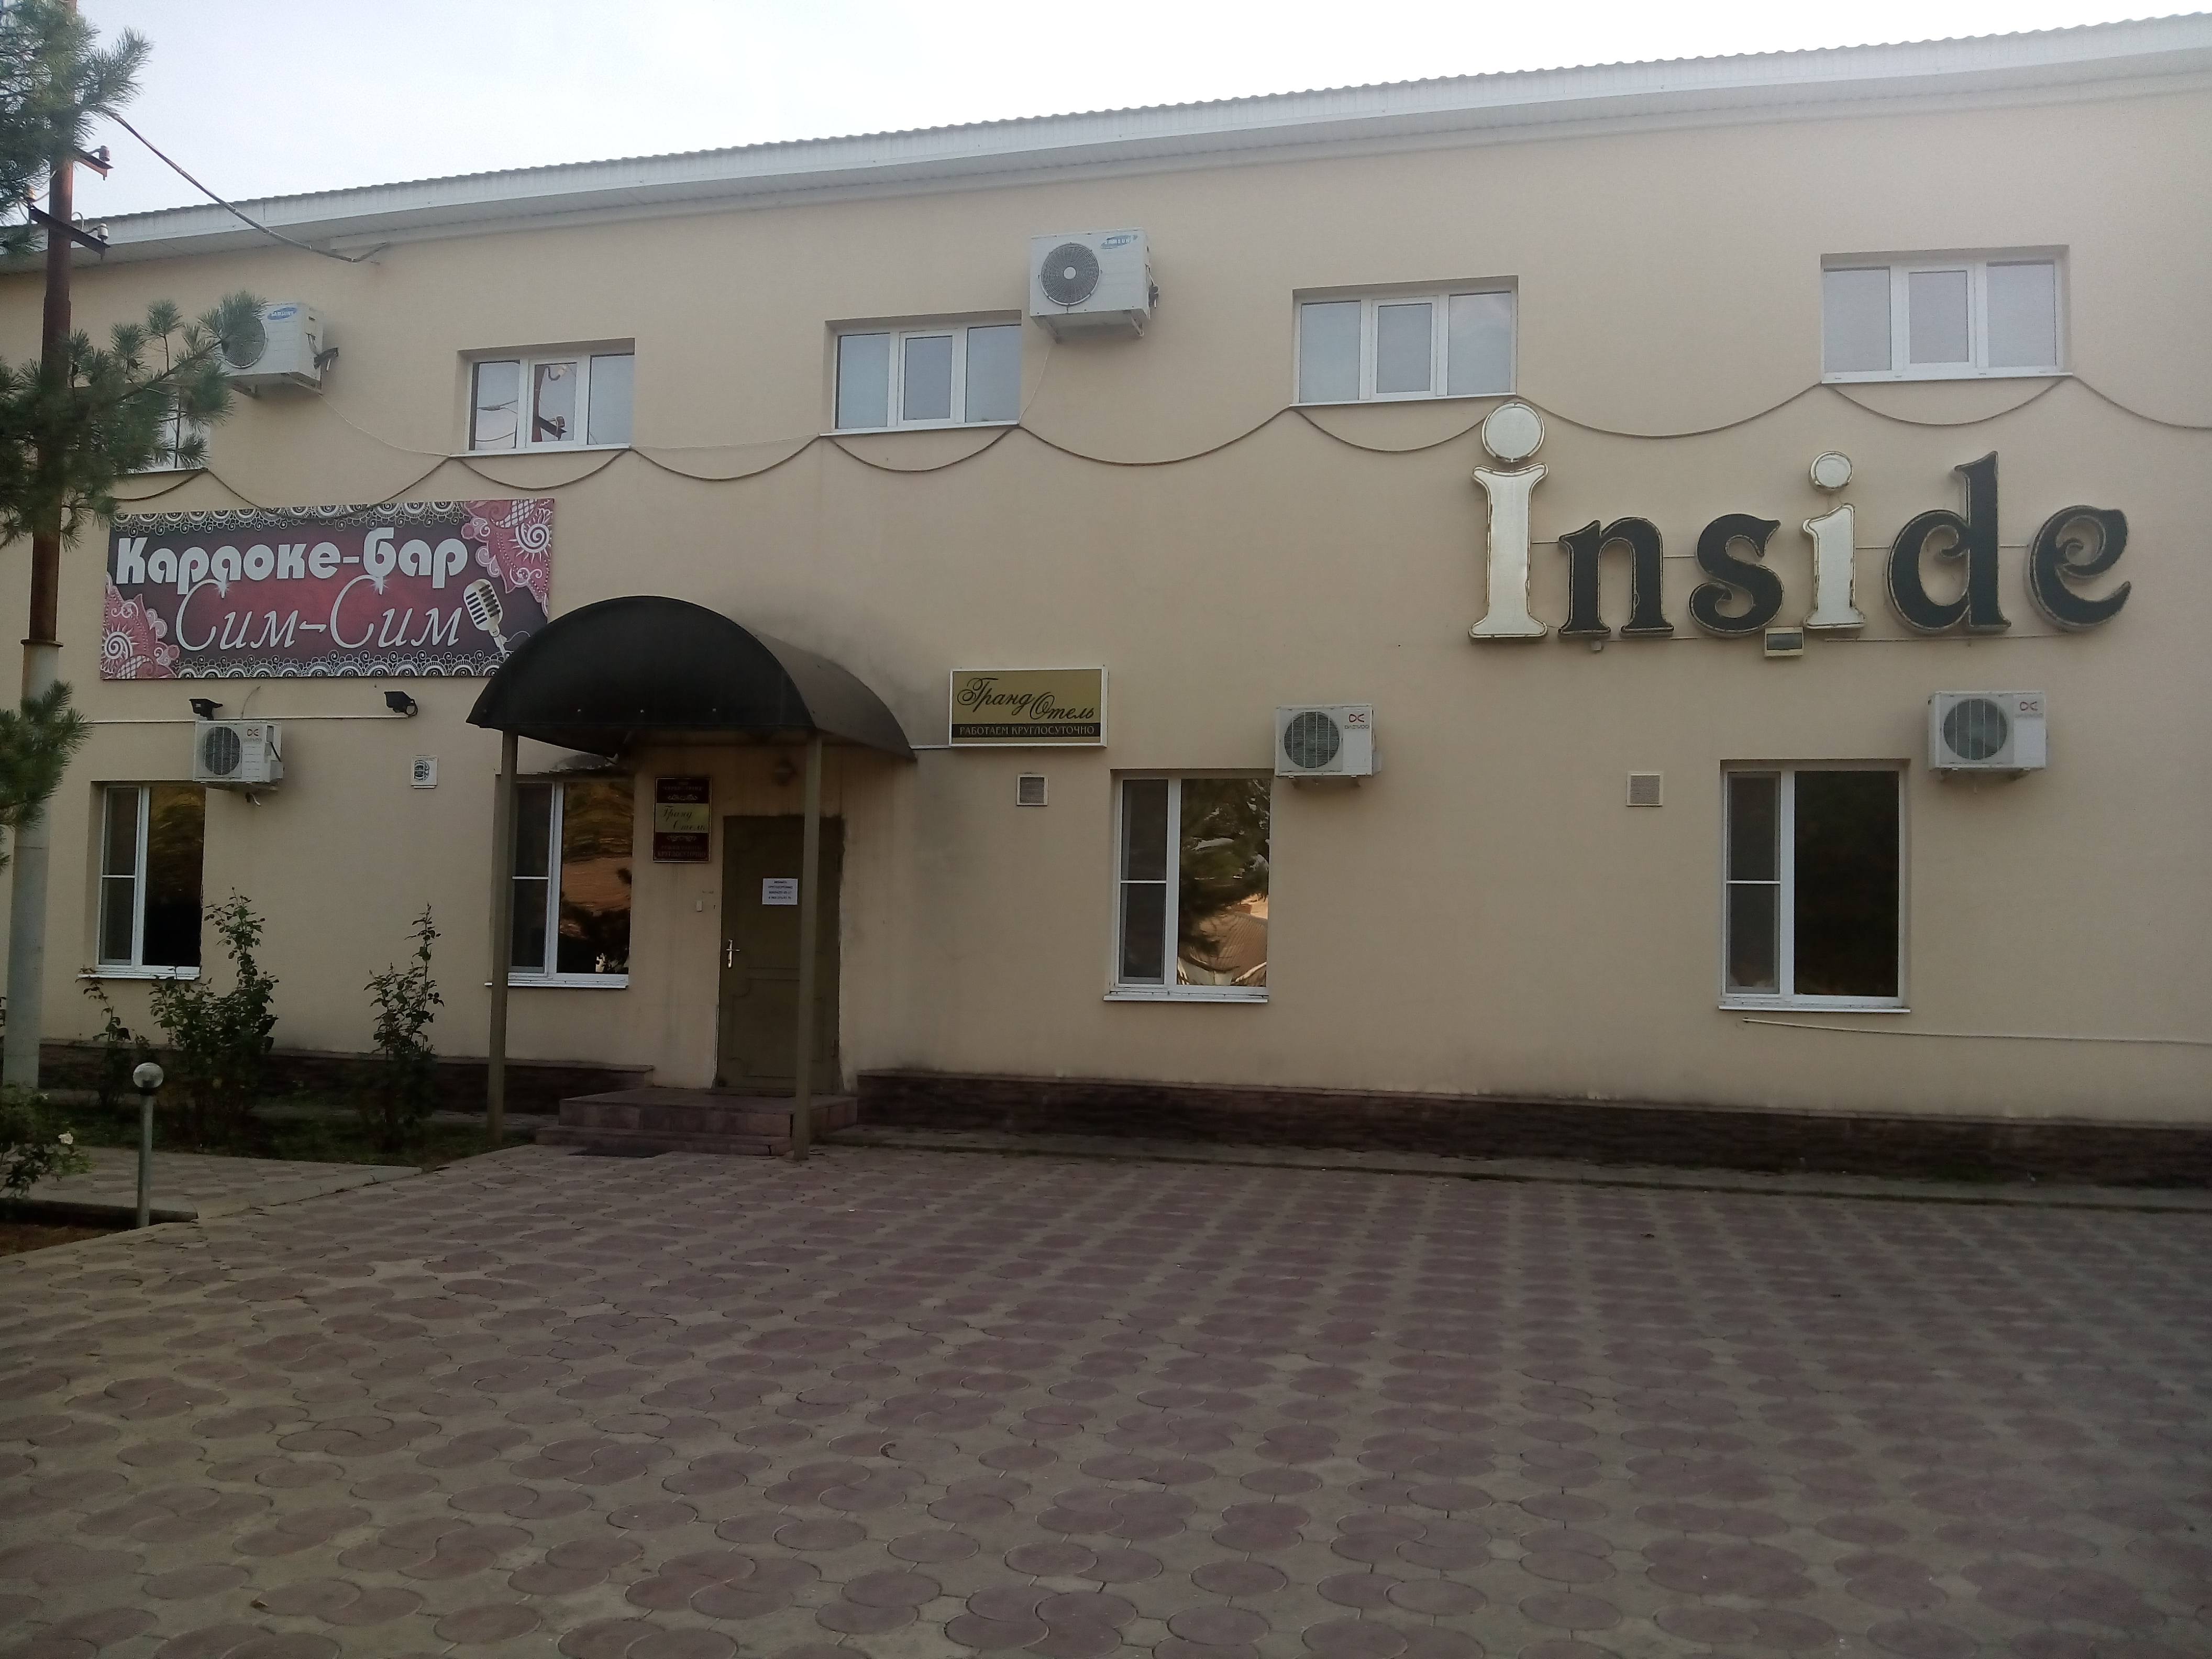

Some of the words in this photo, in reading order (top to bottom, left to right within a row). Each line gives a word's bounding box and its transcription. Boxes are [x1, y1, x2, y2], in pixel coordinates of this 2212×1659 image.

[176, 574, 463, 651] Сим-Сим
[957, 678, 1034, 715] Гранд
[1030, 692, 1094, 720] Отель
[959, 726, 1009, 735] РАБОТАЕМ
[1011, 725, 1095, 735] КРУГЛОСУТОЧНО
